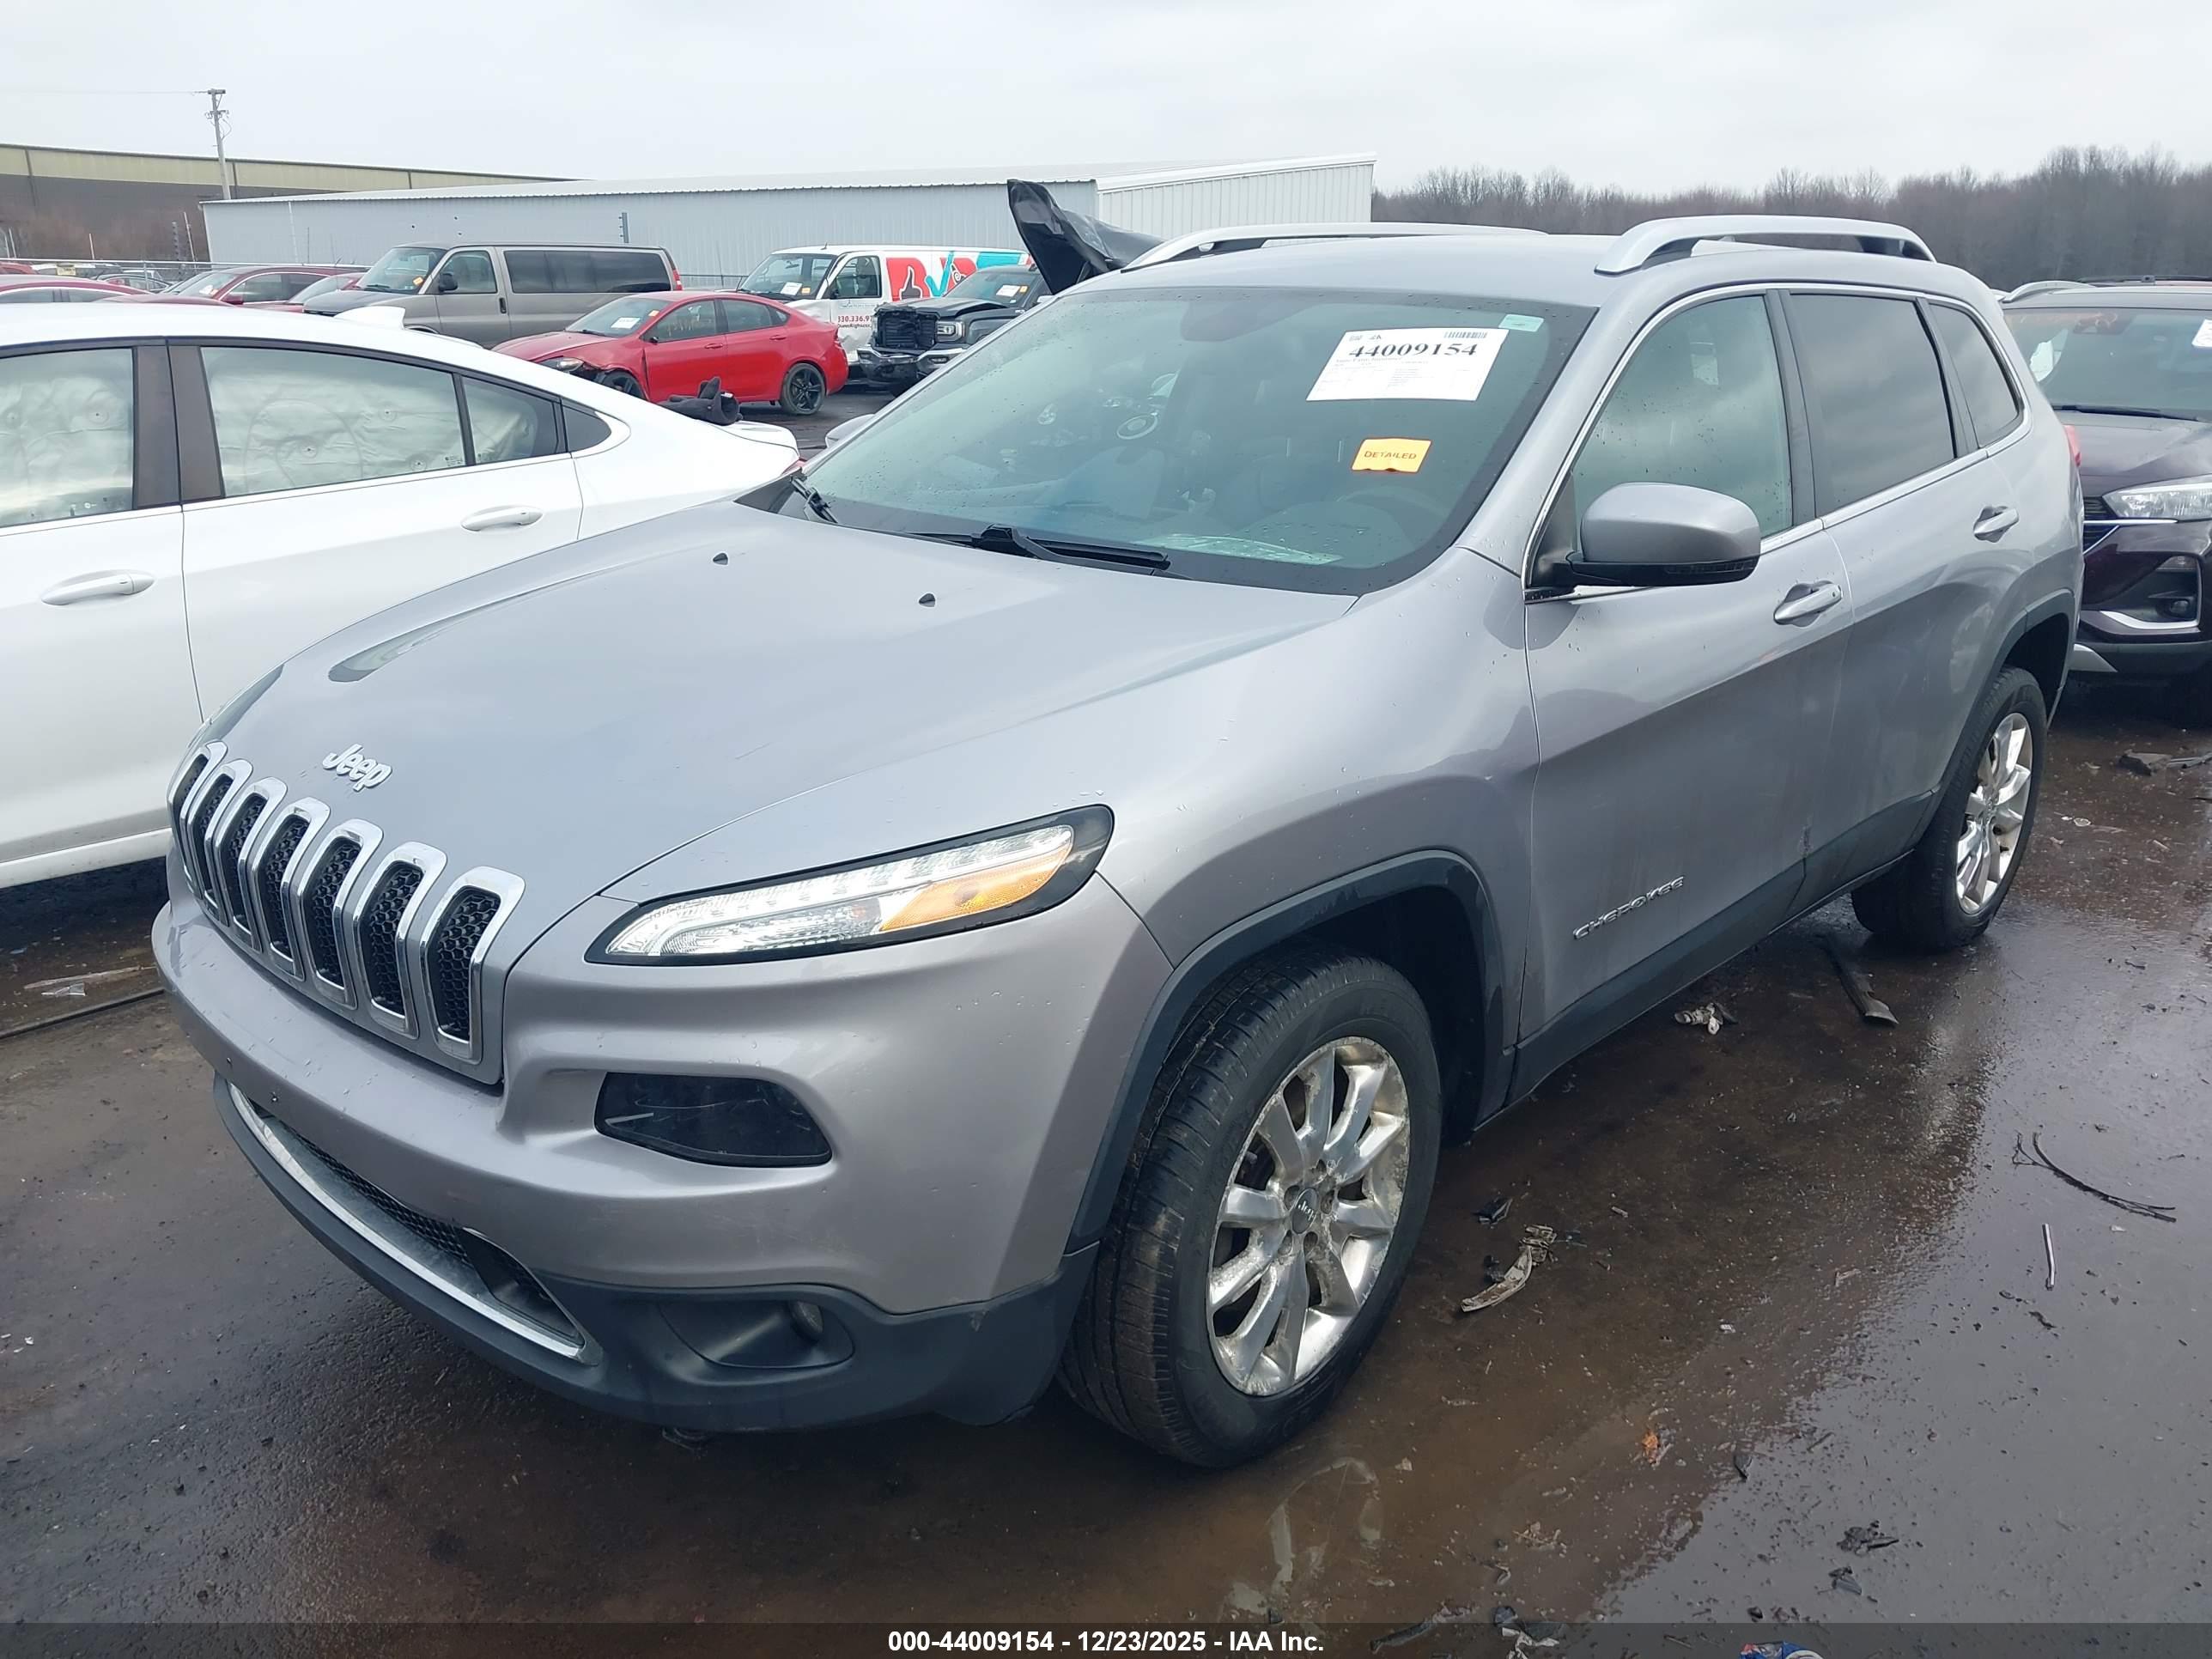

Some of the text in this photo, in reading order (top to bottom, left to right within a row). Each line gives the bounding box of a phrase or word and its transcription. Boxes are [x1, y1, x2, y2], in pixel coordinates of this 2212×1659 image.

[1349, 343, 1478, 358] 44009154
[1364, 450, 1417, 459] DETAILED
[322, 743, 393, 793] Jeep
[1573, 876, 1684, 939] CHEROKEE
